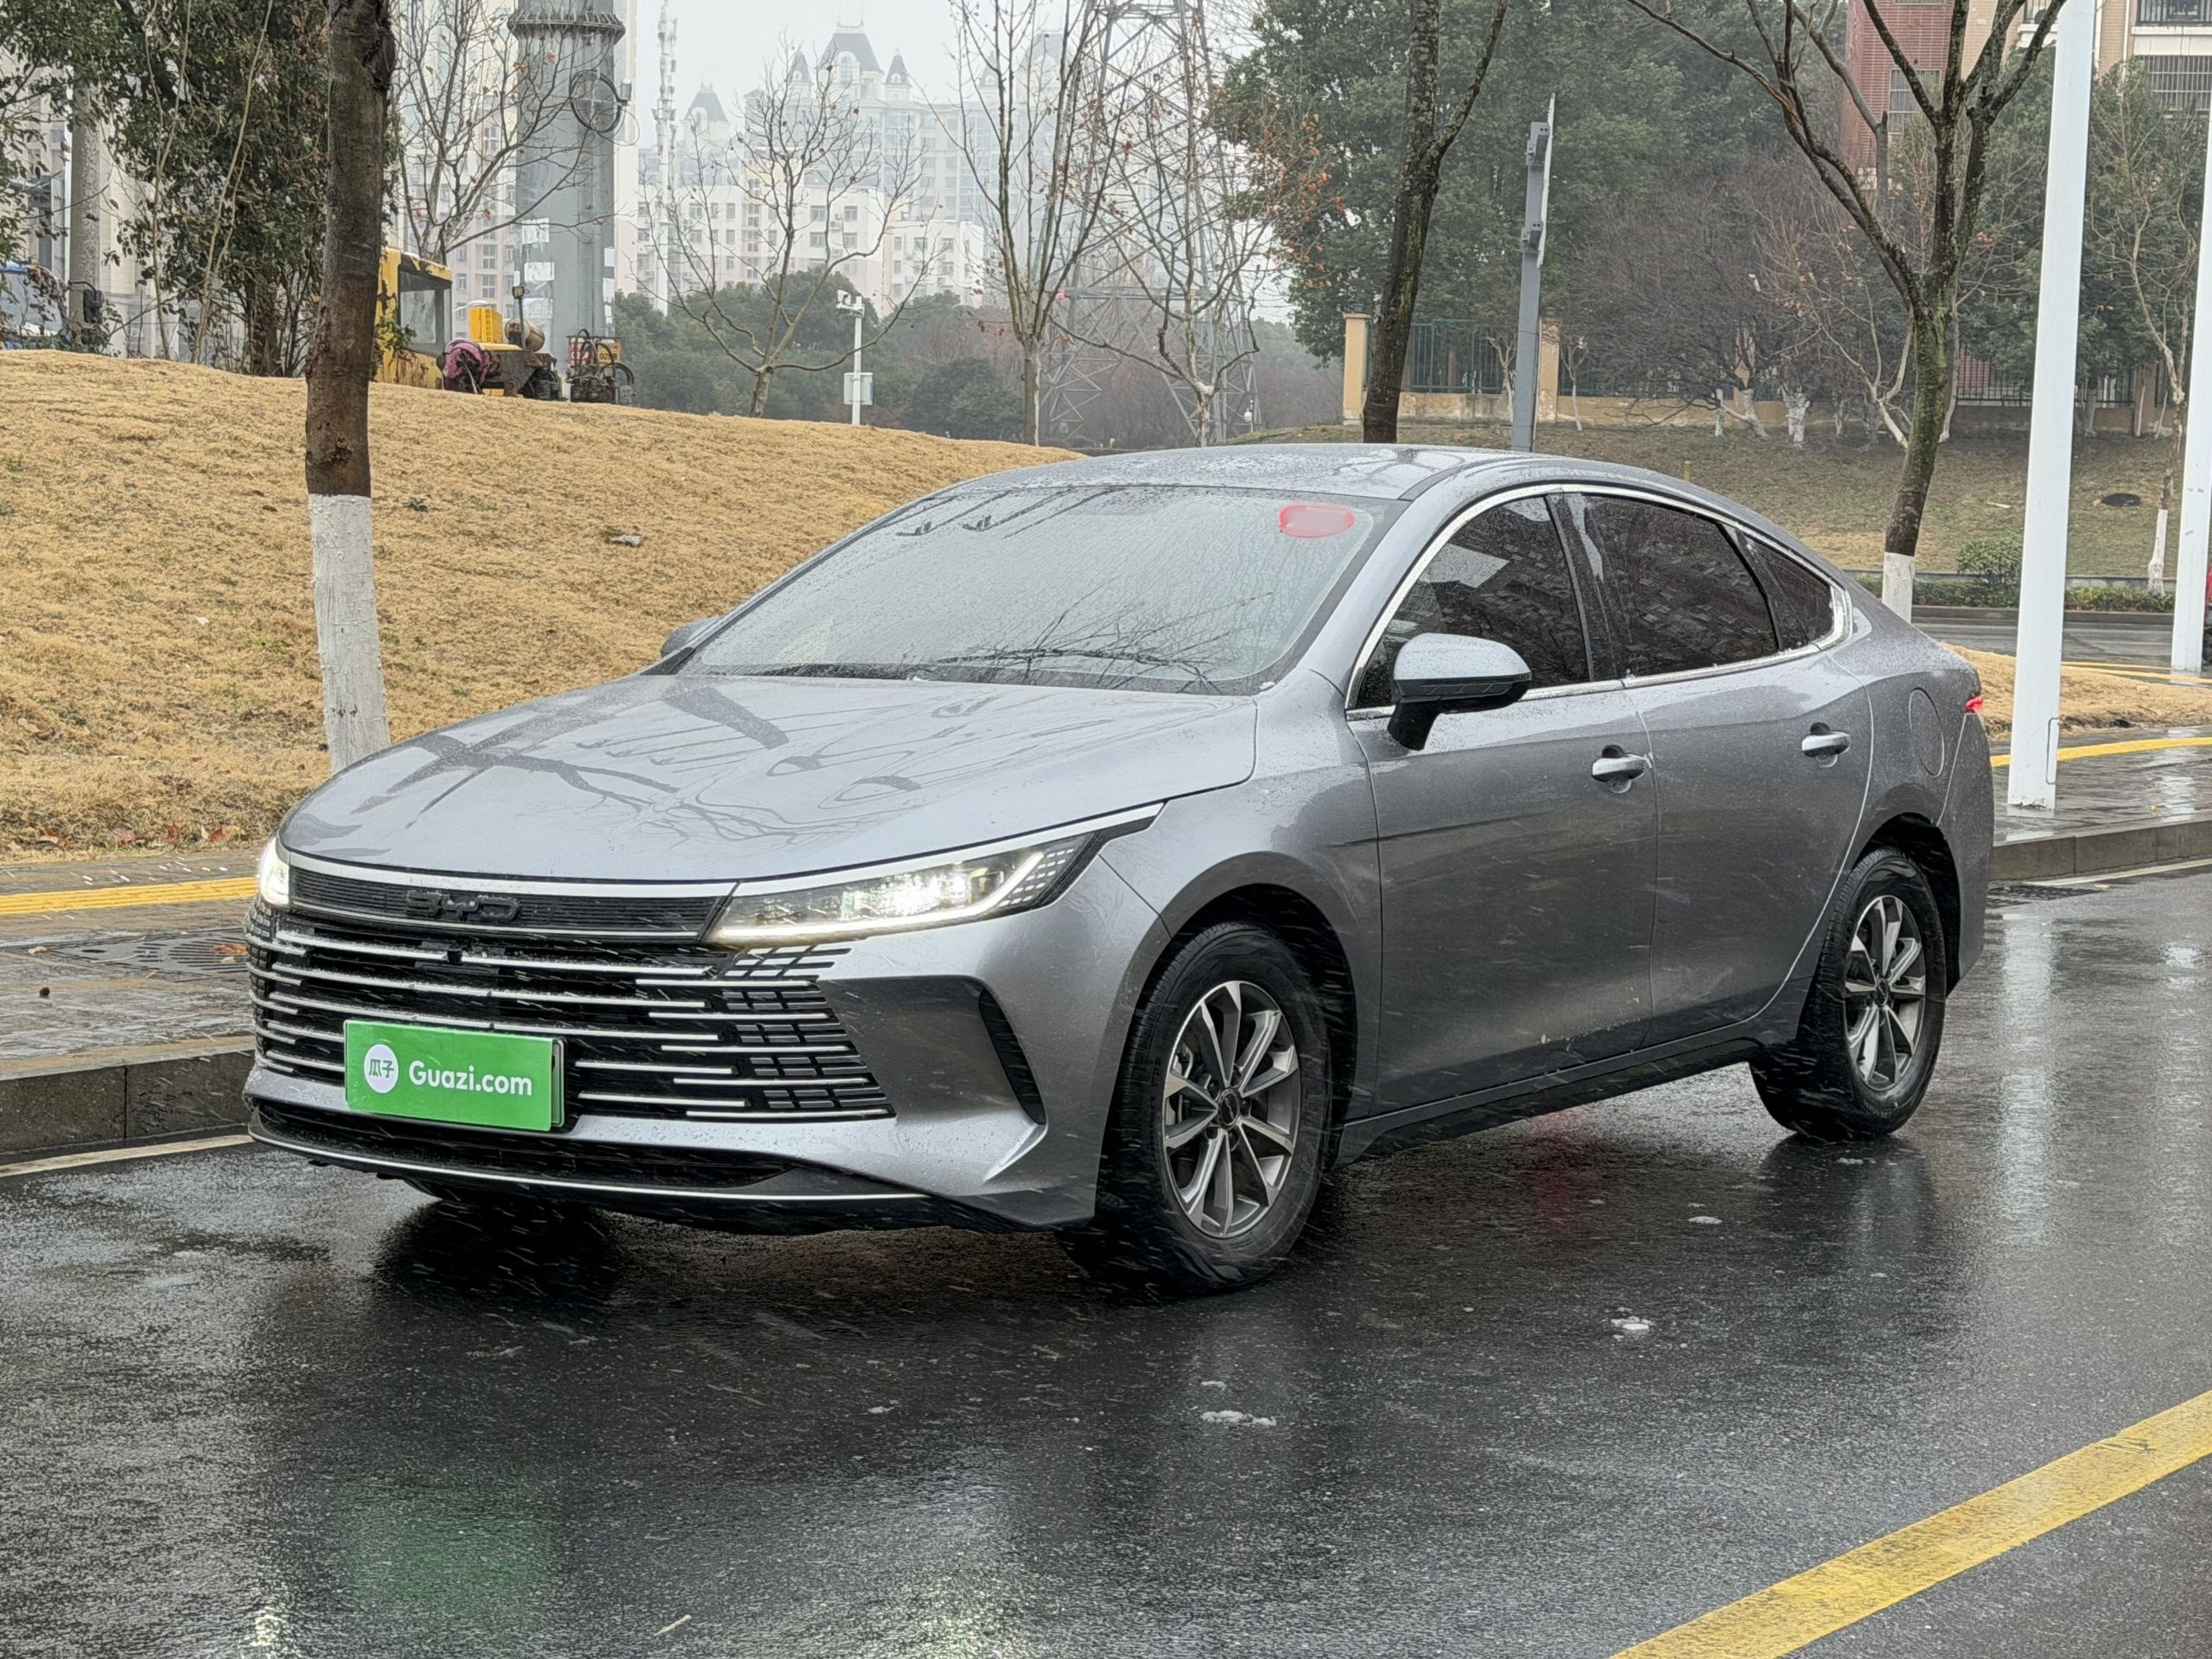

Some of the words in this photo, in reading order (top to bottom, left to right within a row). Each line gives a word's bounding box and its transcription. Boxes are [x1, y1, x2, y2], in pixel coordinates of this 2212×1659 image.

[406, 891, 518, 922] BYD
[369, 1059, 395, 1078] 瓜子
[409, 1060, 532, 1096] Guazi.com
